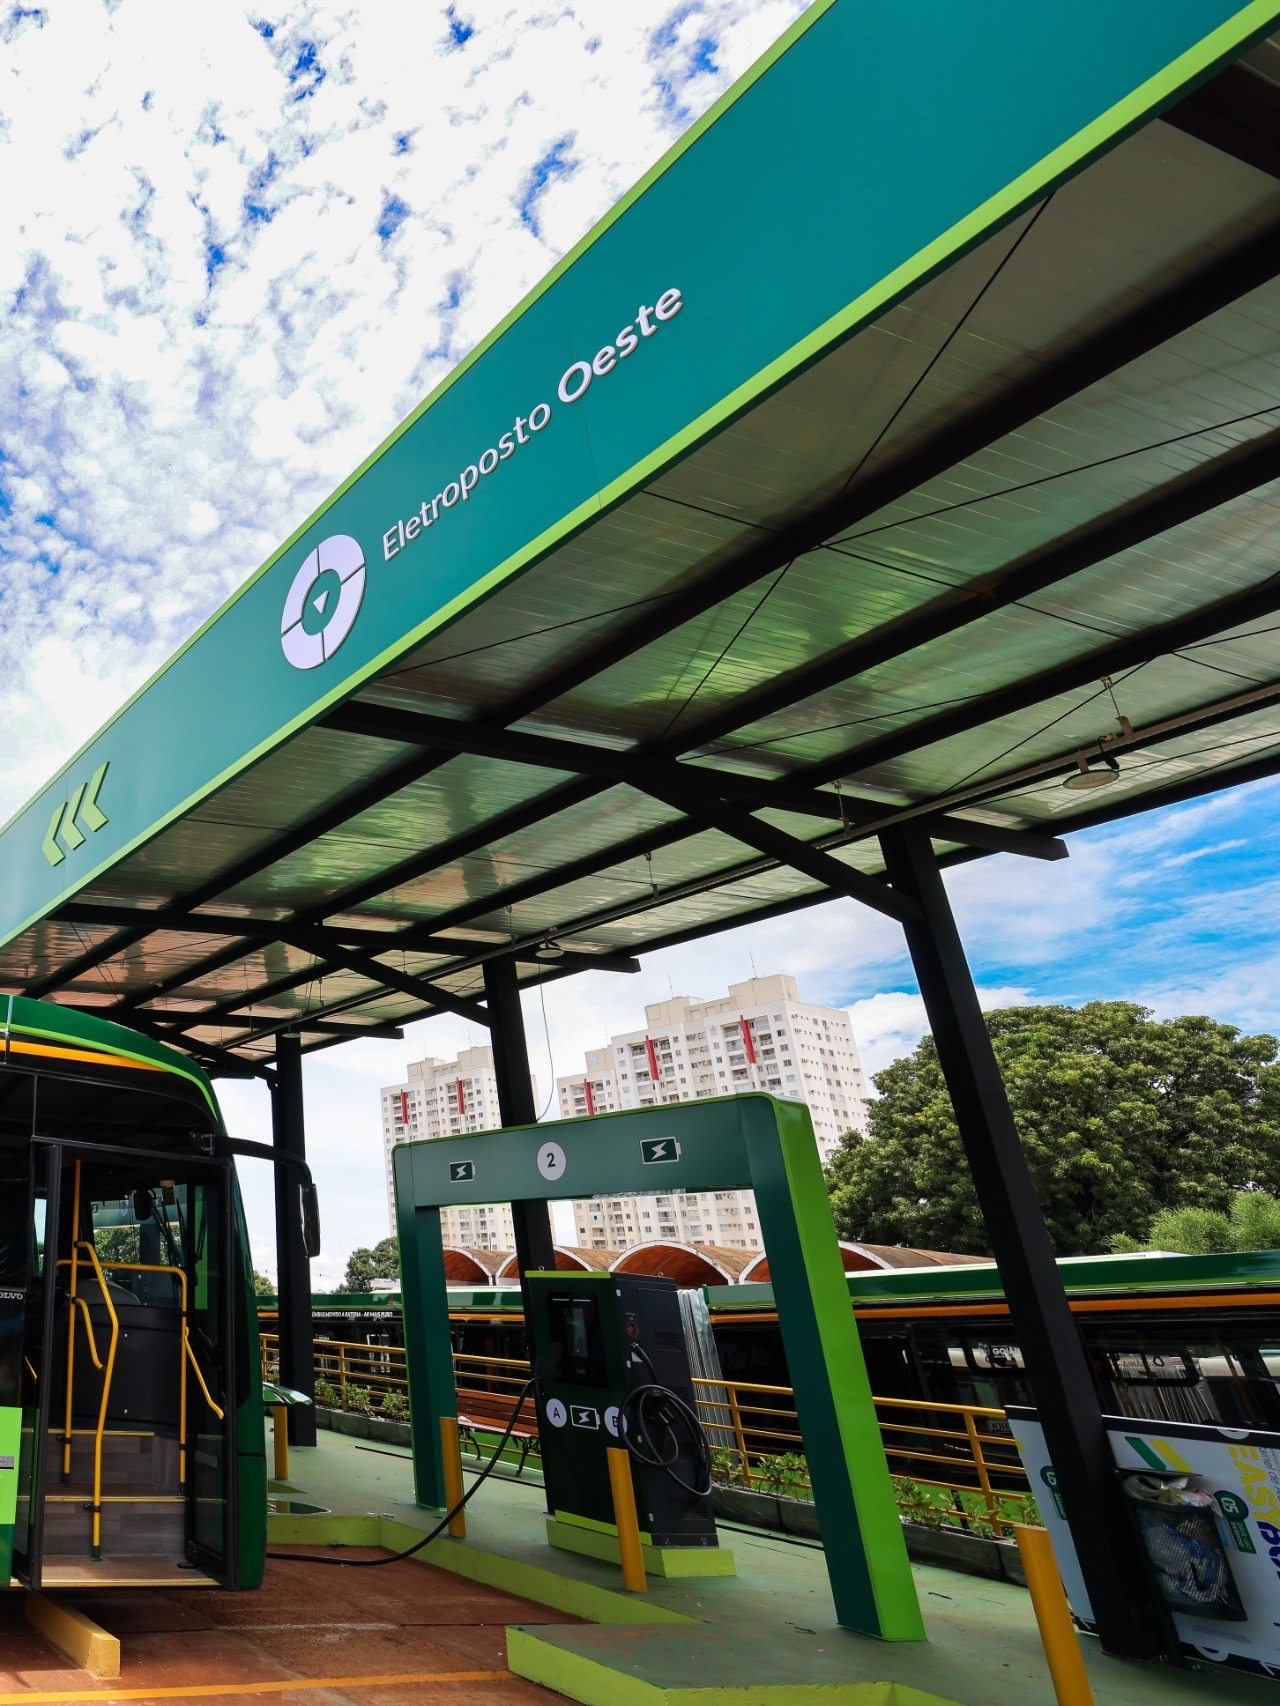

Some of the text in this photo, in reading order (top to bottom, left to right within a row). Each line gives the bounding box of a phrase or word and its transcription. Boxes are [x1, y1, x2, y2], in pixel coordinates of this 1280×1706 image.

[382, 288, 683, 561] Eletroposto Oeste
[546, 1152, 556, 1168] 2
[553, 1407, 561, 1419] A
[1220, 1497, 1239, 1514] 05
